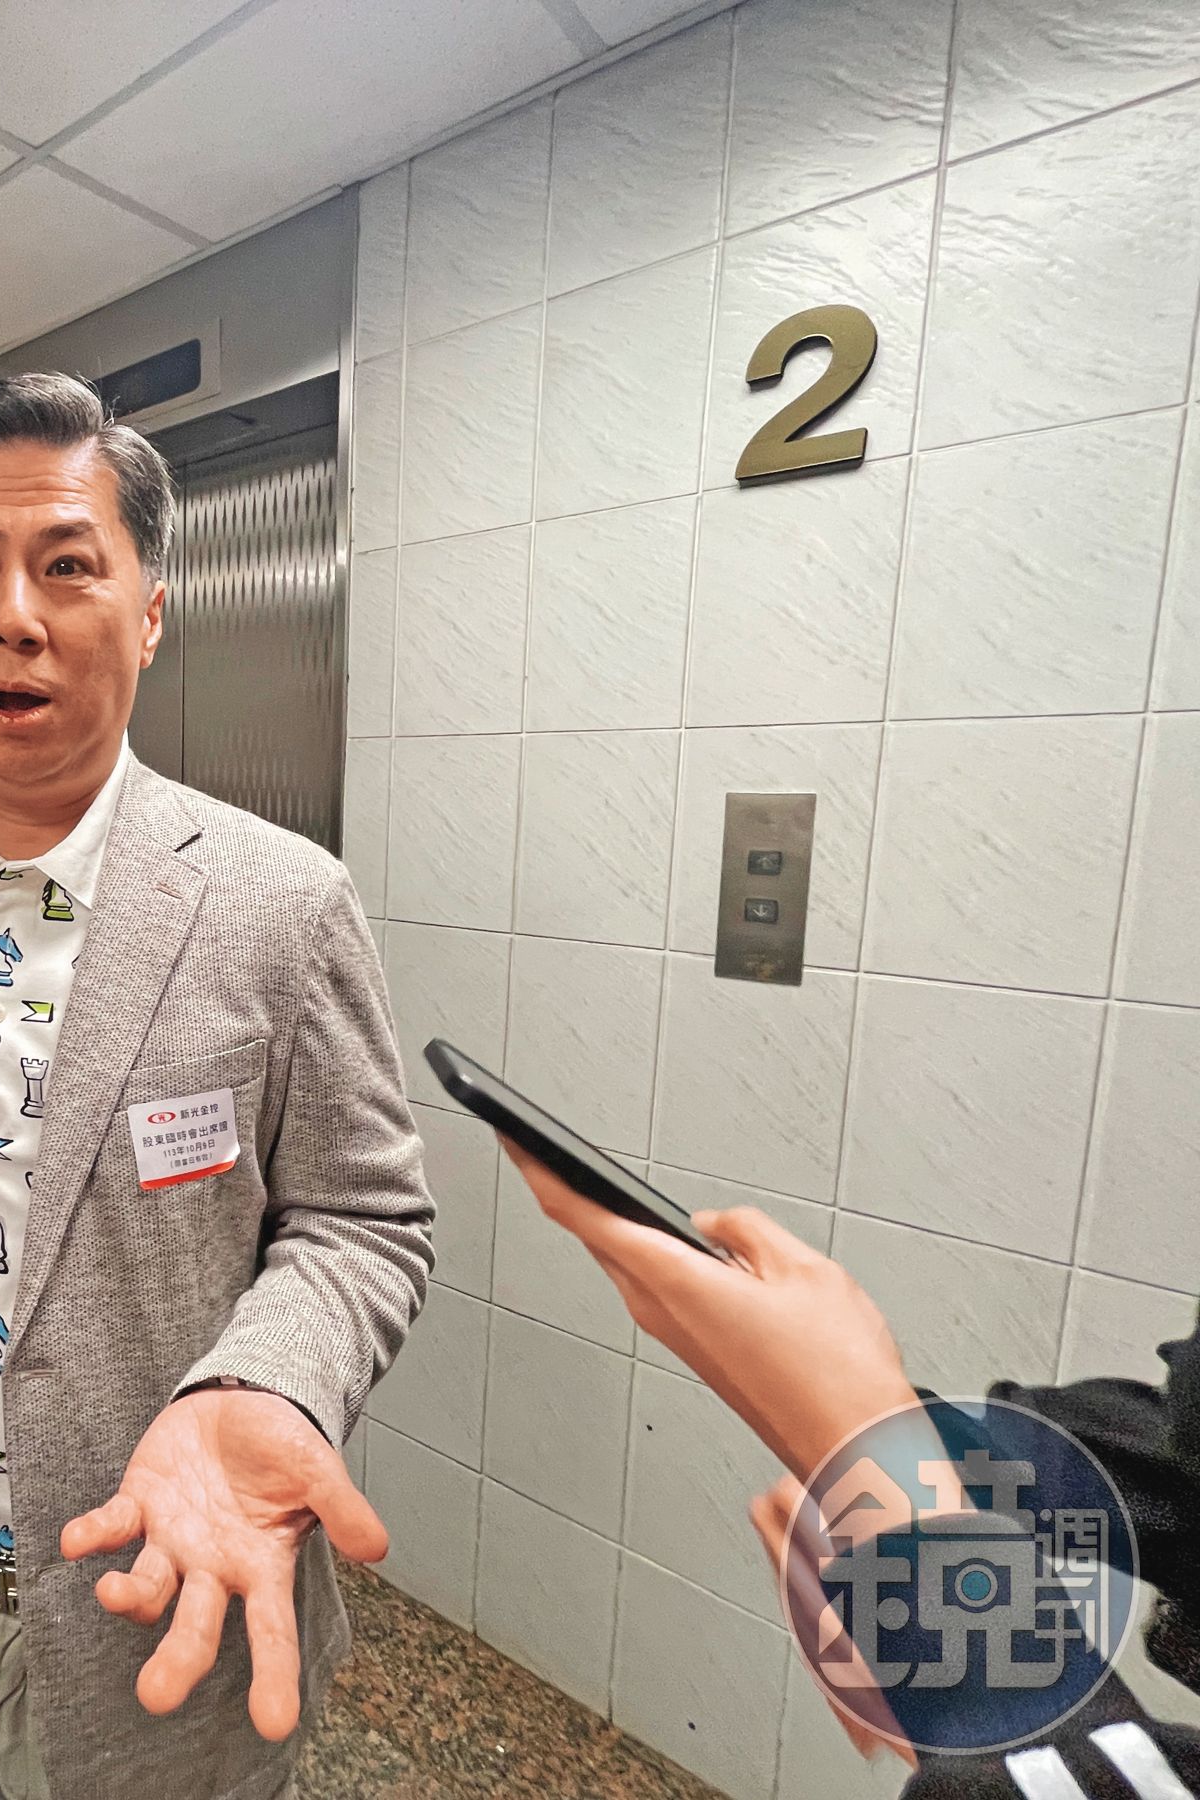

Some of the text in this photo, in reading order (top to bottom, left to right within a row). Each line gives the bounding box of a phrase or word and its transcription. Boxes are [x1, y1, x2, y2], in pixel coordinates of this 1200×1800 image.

[735, 304, 878, 487] 2
[180, 1103, 218, 1119] 新光金控
